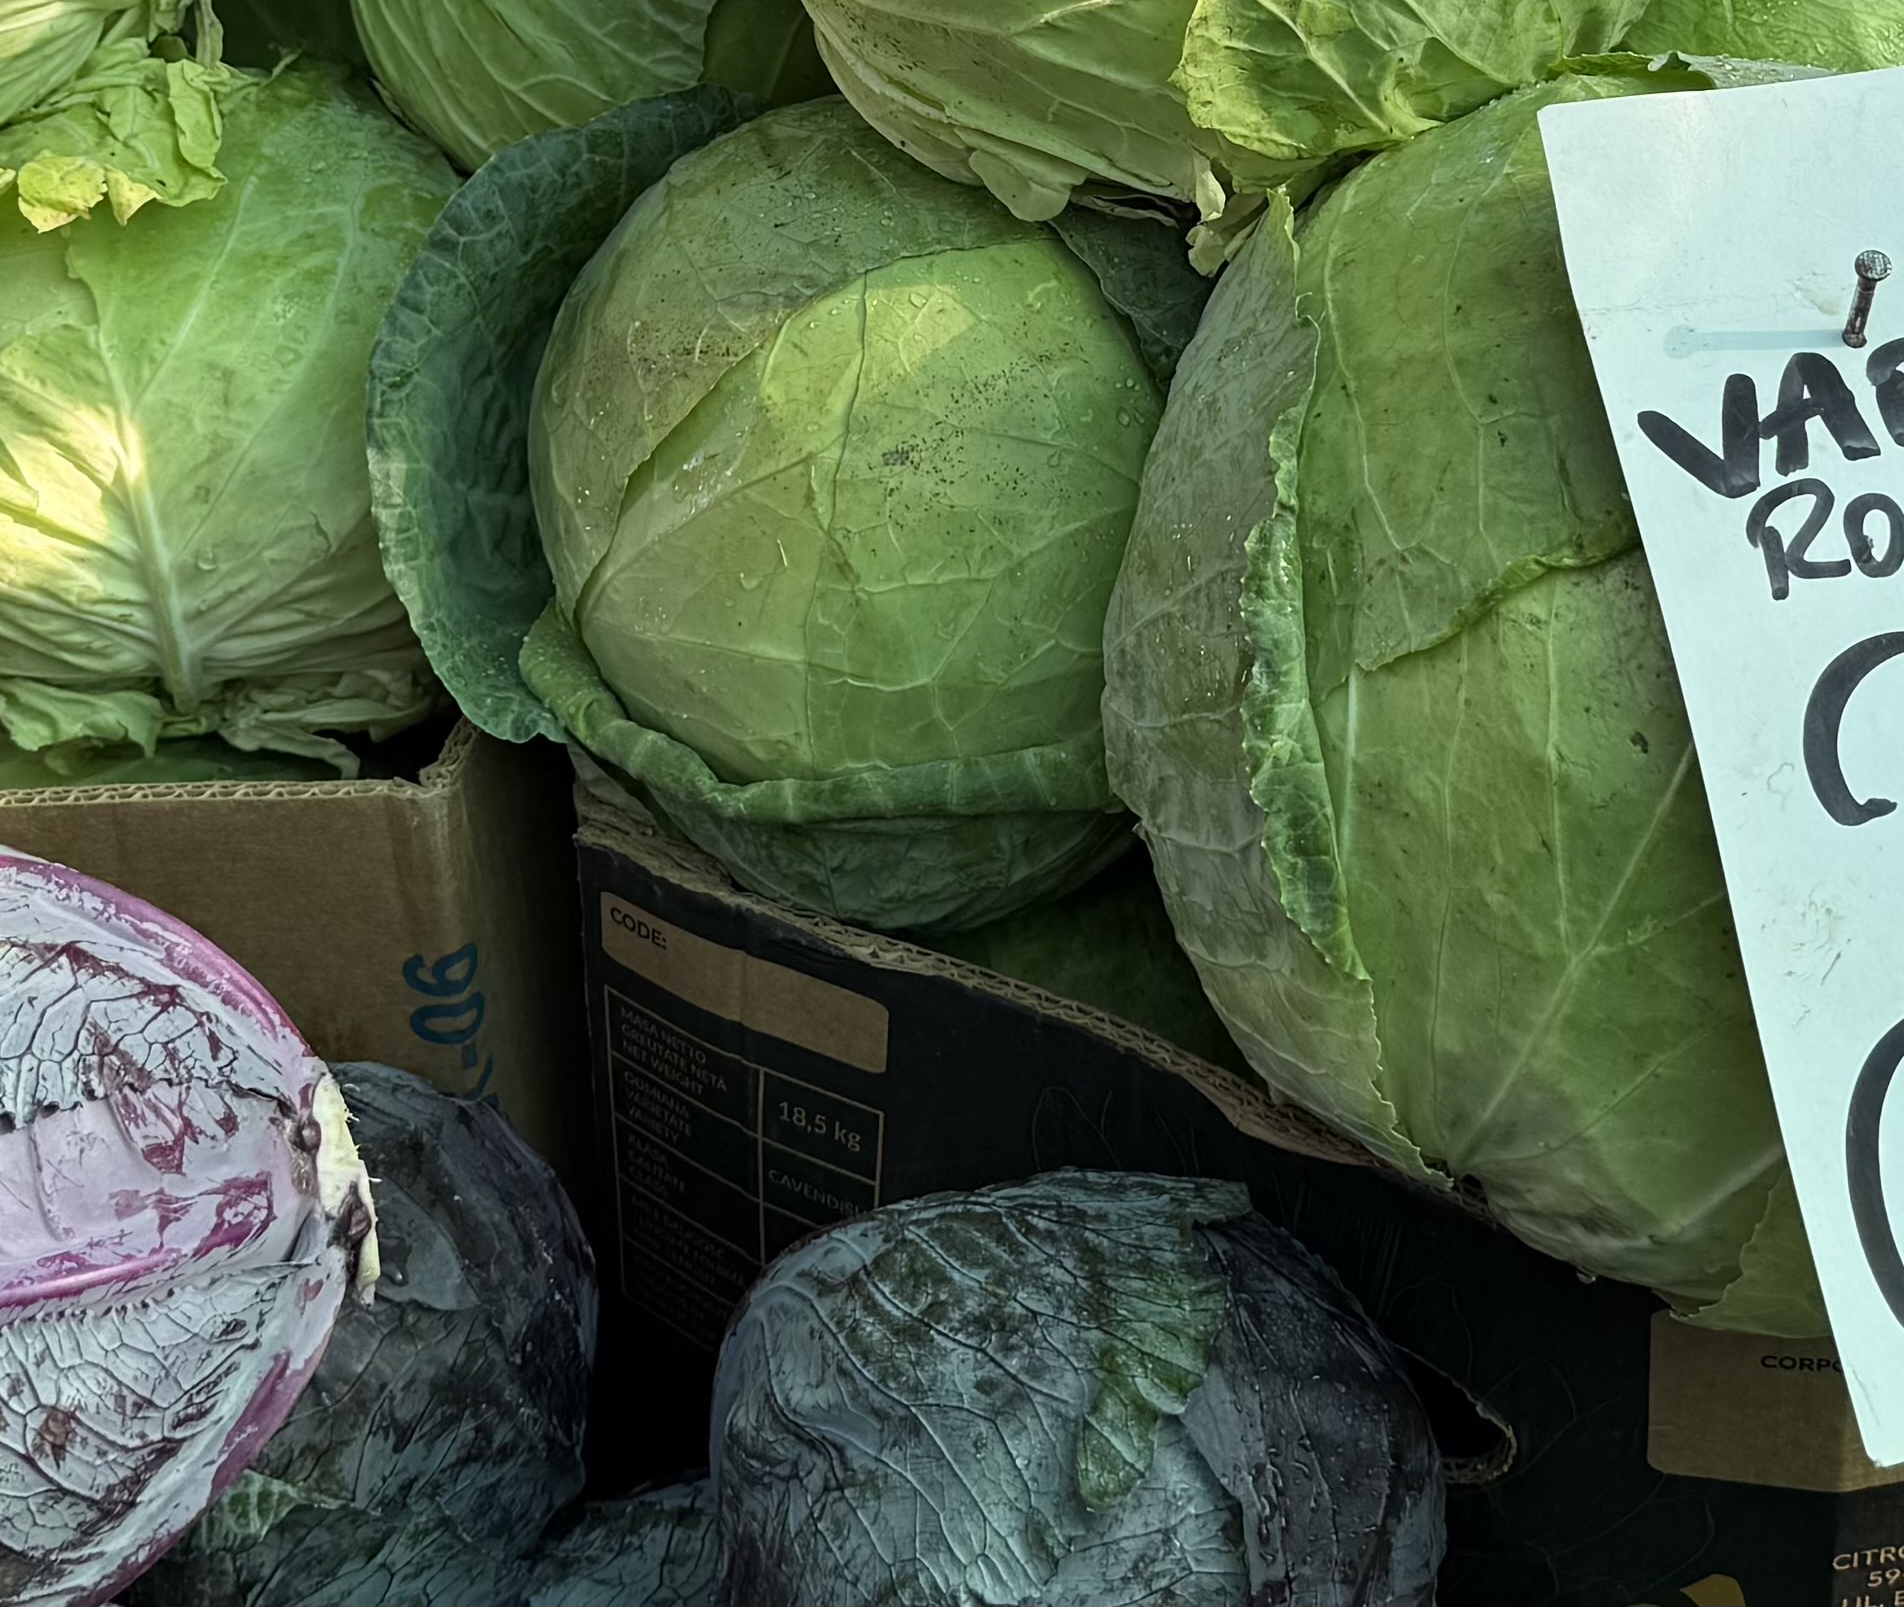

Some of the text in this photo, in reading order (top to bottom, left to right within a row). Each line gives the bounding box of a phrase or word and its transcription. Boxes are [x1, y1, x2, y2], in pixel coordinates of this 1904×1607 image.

[609, 905, 668, 951] CODE:
[779, 1101, 862, 1153] 18,5 kg
